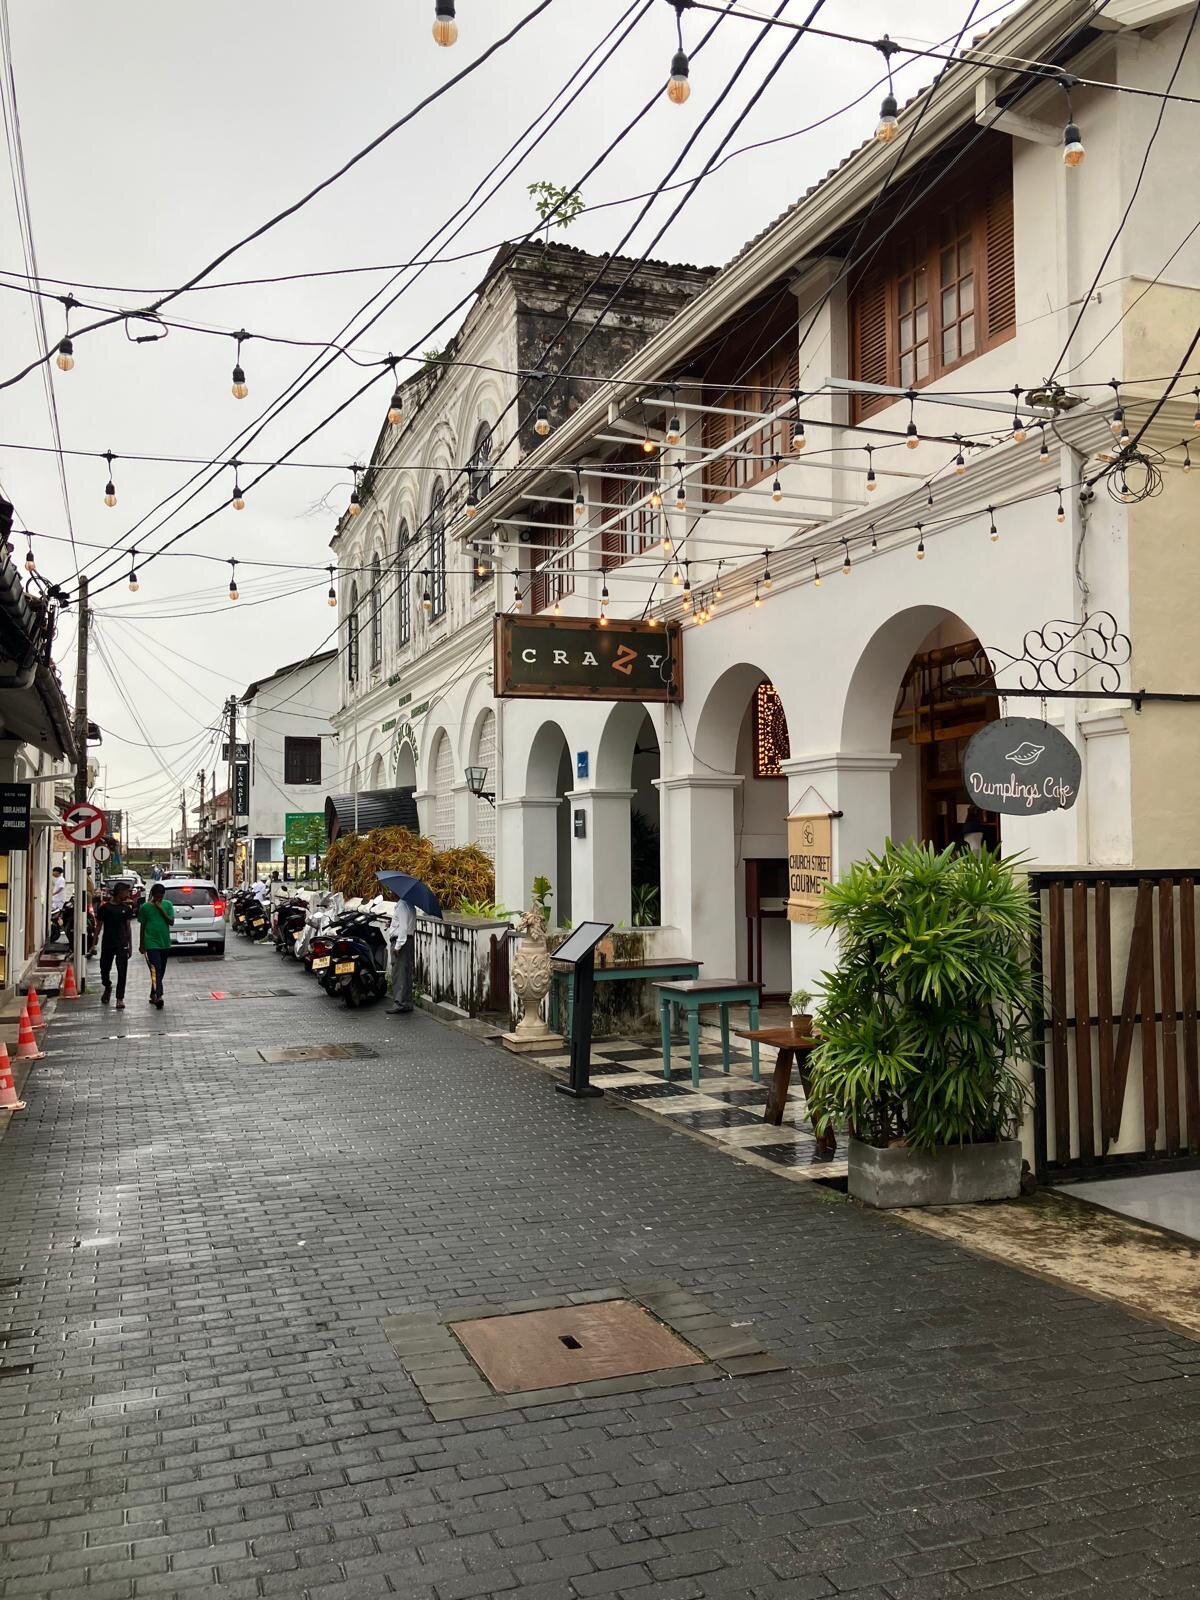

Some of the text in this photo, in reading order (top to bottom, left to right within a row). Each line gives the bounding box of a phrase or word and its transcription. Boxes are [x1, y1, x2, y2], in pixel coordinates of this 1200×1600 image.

[522, 644, 662, 675] CRAZY
[970, 772, 1074, 807] Dumplings Cafe
[789, 855, 831, 872] CHURCH STREET
